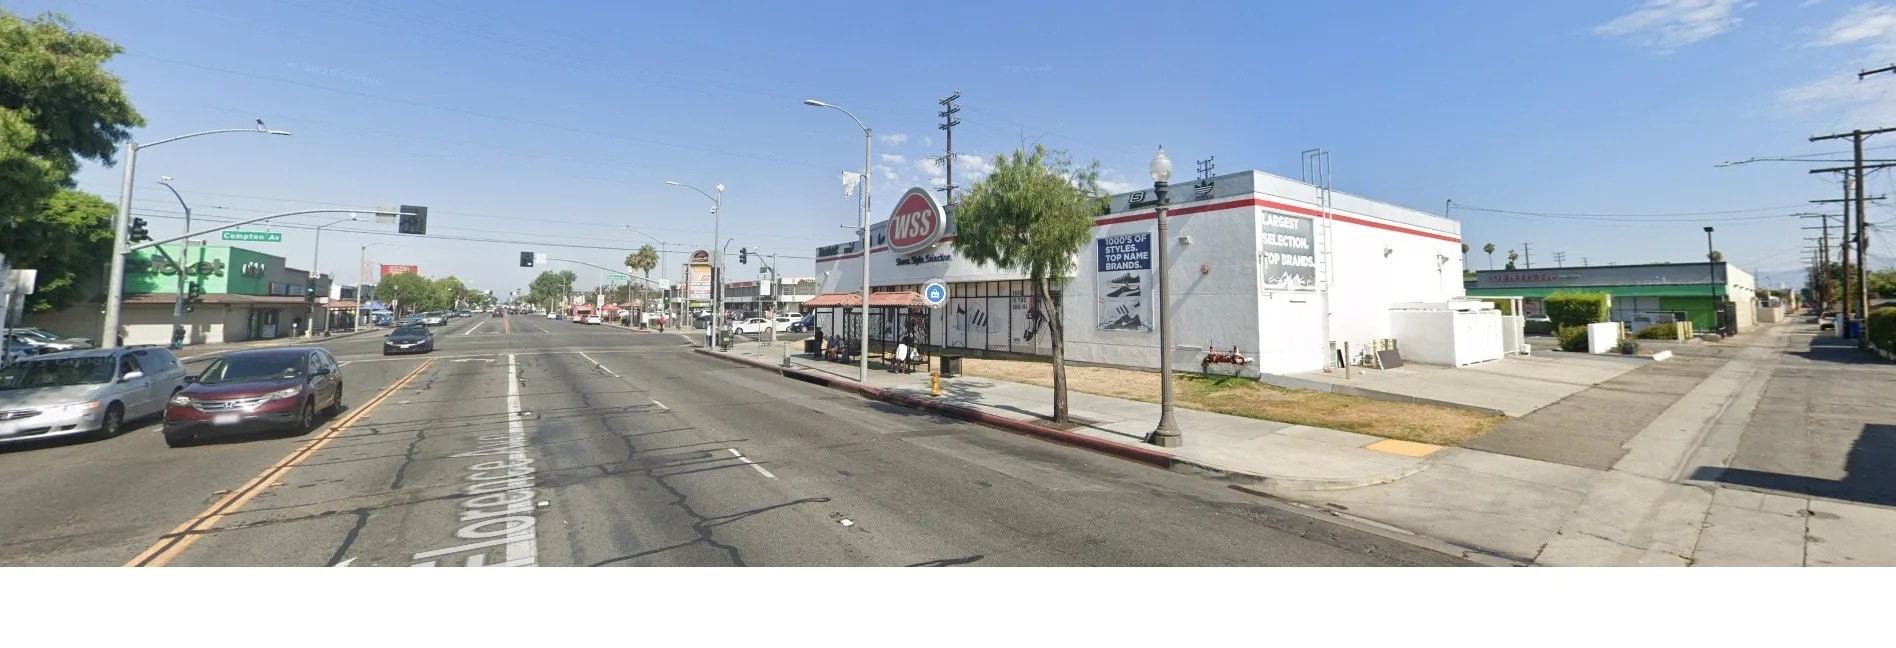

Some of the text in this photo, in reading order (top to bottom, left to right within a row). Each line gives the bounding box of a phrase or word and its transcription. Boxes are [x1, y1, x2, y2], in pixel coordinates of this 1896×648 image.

[892, 209, 932, 239] WSS
[1262, 212, 1299, 230] LARGEST
[223, 232, 265, 241] Compton
[1134, 234, 1147, 243] OF
[1262, 232, 1309, 250] SELECTION.
[1105, 244, 1138, 254] STYLES.
[1105, 251, 1149, 262] TOP NAME
[1263, 250, 1316, 268] TOP BRANDS.
[1105, 260, 1143, 270] BRANDS.
